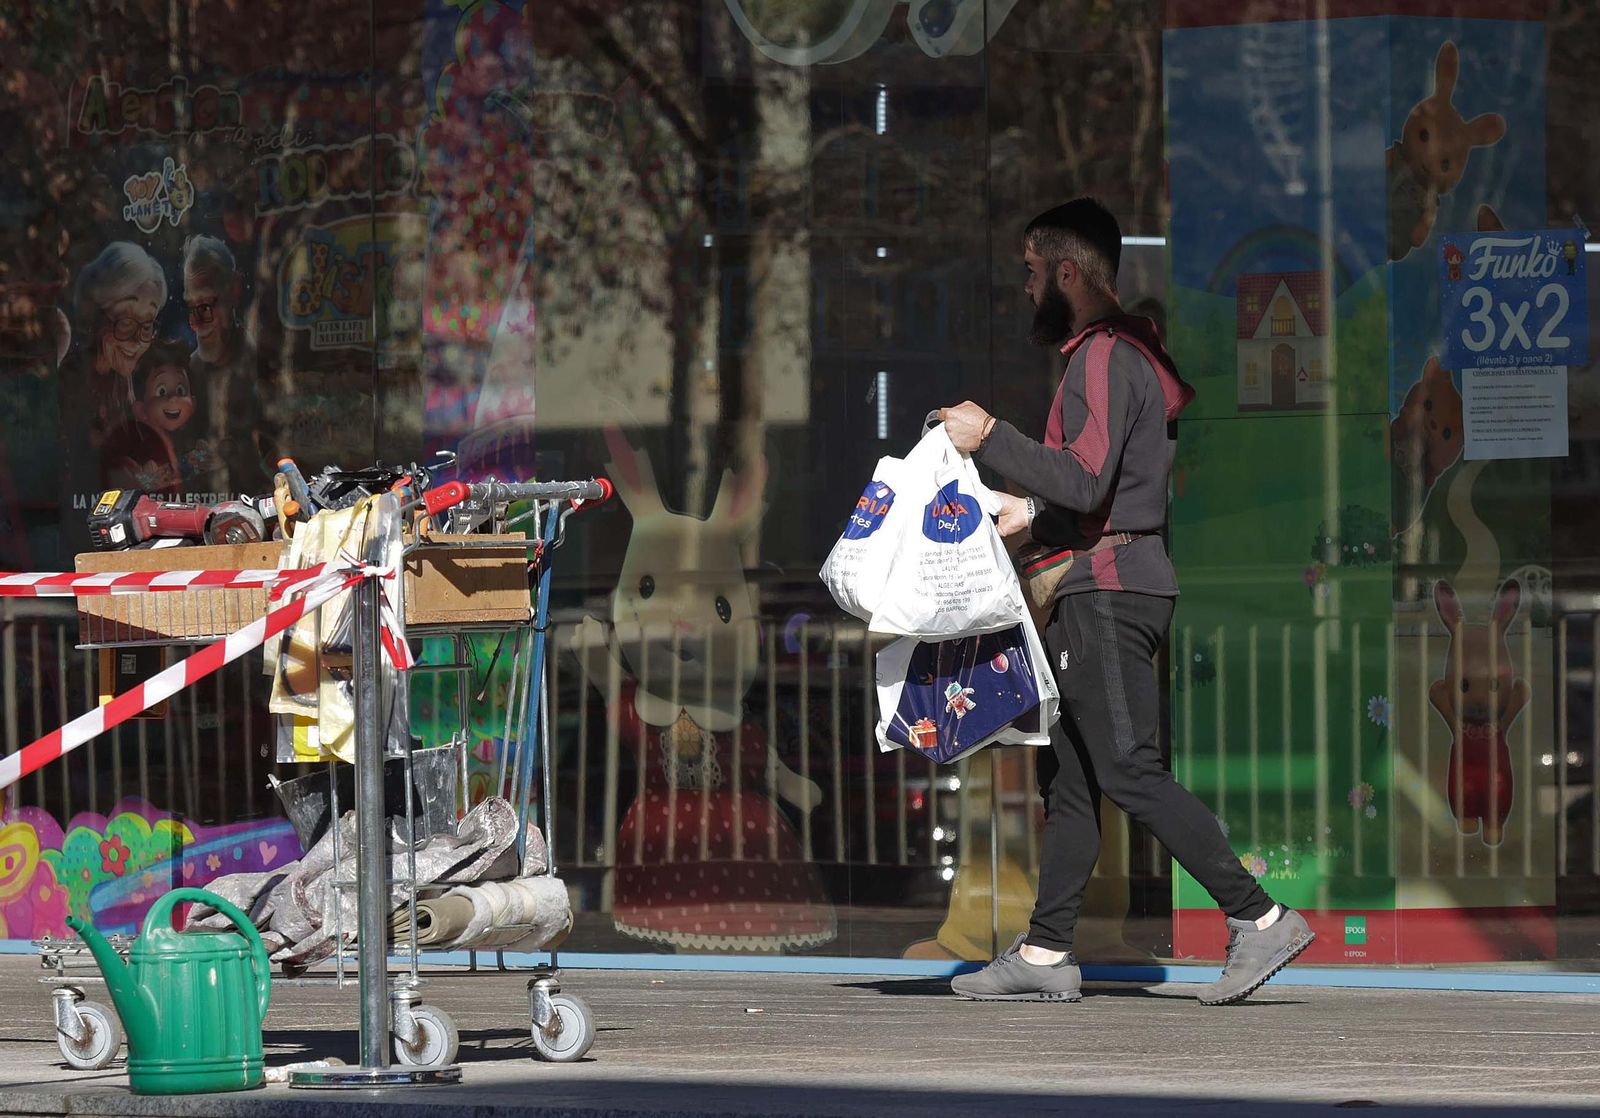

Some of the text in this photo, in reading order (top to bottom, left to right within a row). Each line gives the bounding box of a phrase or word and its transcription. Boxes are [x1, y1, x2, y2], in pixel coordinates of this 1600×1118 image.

[127, 175, 161, 203] TOY
[124, 200, 170, 219] PLANET
[1468, 235, 1557, 281] Funko
[1461, 283, 1571, 352] 3x2
[1508, 355, 1514, 364] 3
[73, 493, 87, 509] LA
[1345, 926, 1366, 934] EPOCH
